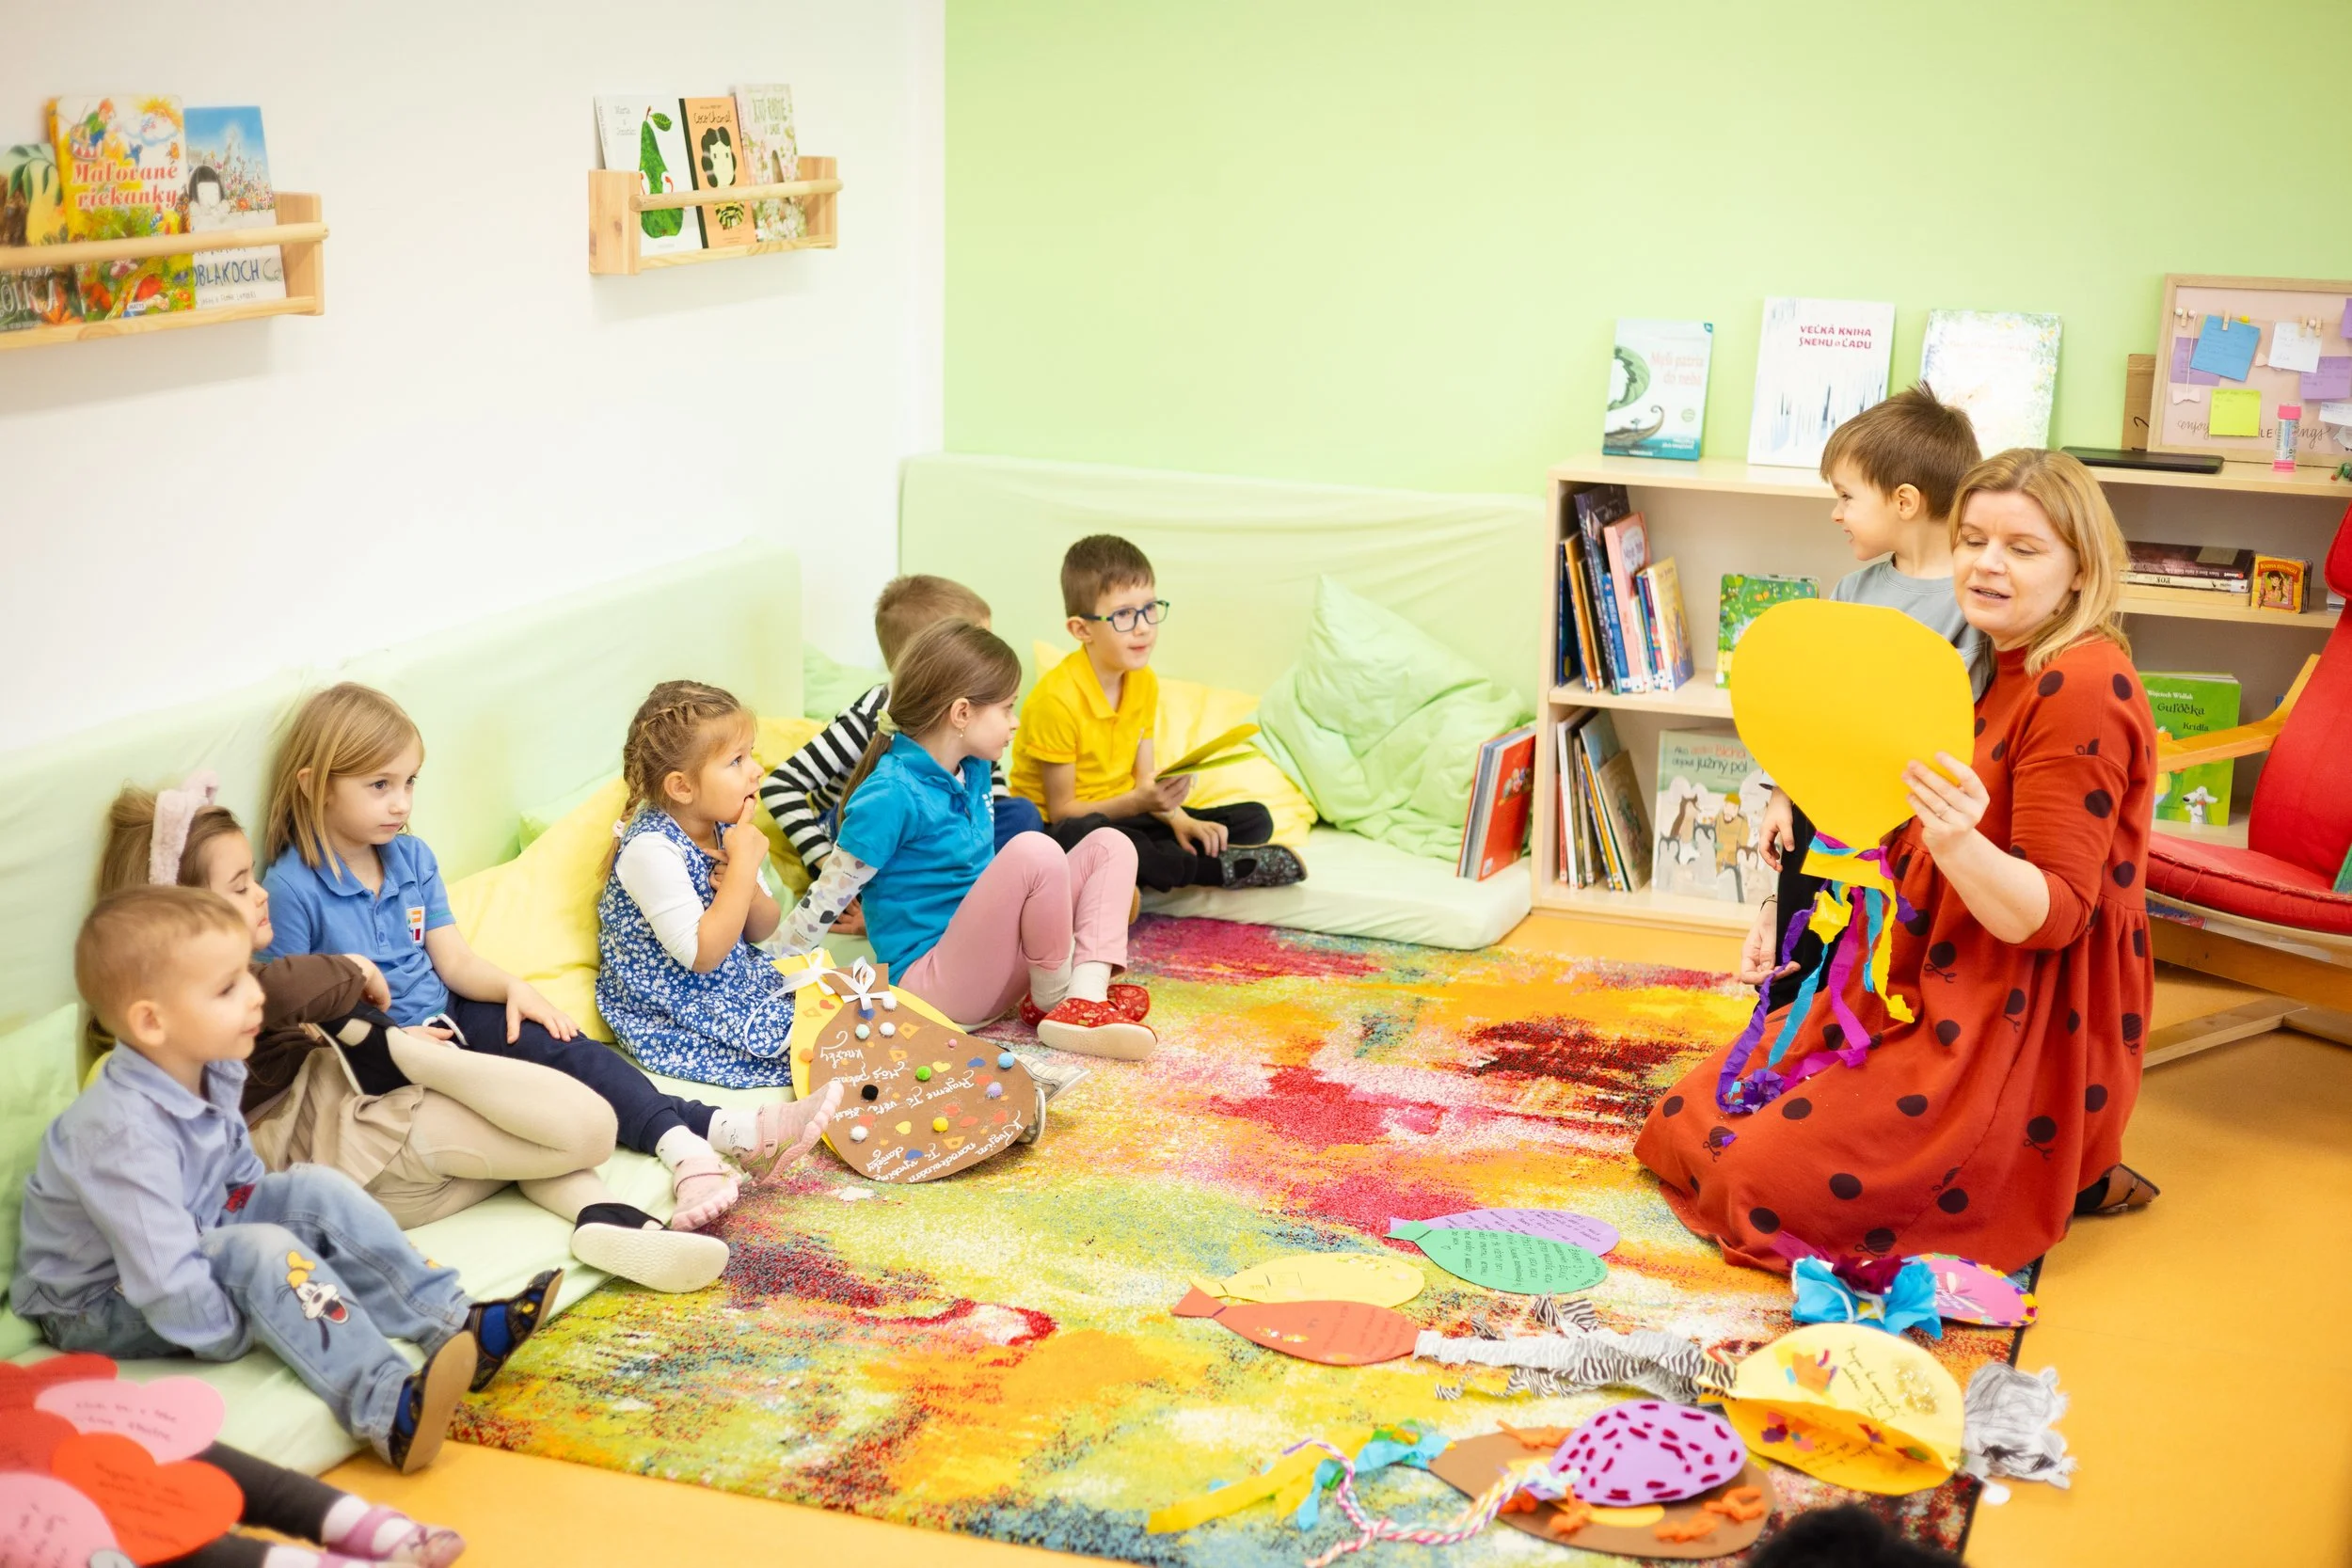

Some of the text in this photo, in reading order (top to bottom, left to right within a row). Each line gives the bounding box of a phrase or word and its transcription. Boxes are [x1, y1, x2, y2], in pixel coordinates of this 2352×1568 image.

[78, 183, 177, 209] riekanky
[1800, 325, 1872, 337] VEĽKÁ KNIHA
[1799, 337, 1834, 347] SNEHU
[1841, 338, 1872, 349] ĽADU
[1663, 370, 1702, 385] do neba
[2177, 420, 2210, 444] enjoy
[1696, 757, 1728, 774] južný
[1730, 760, 1748, 775] pól
[927, 1069, 975, 1100] Prajeme
